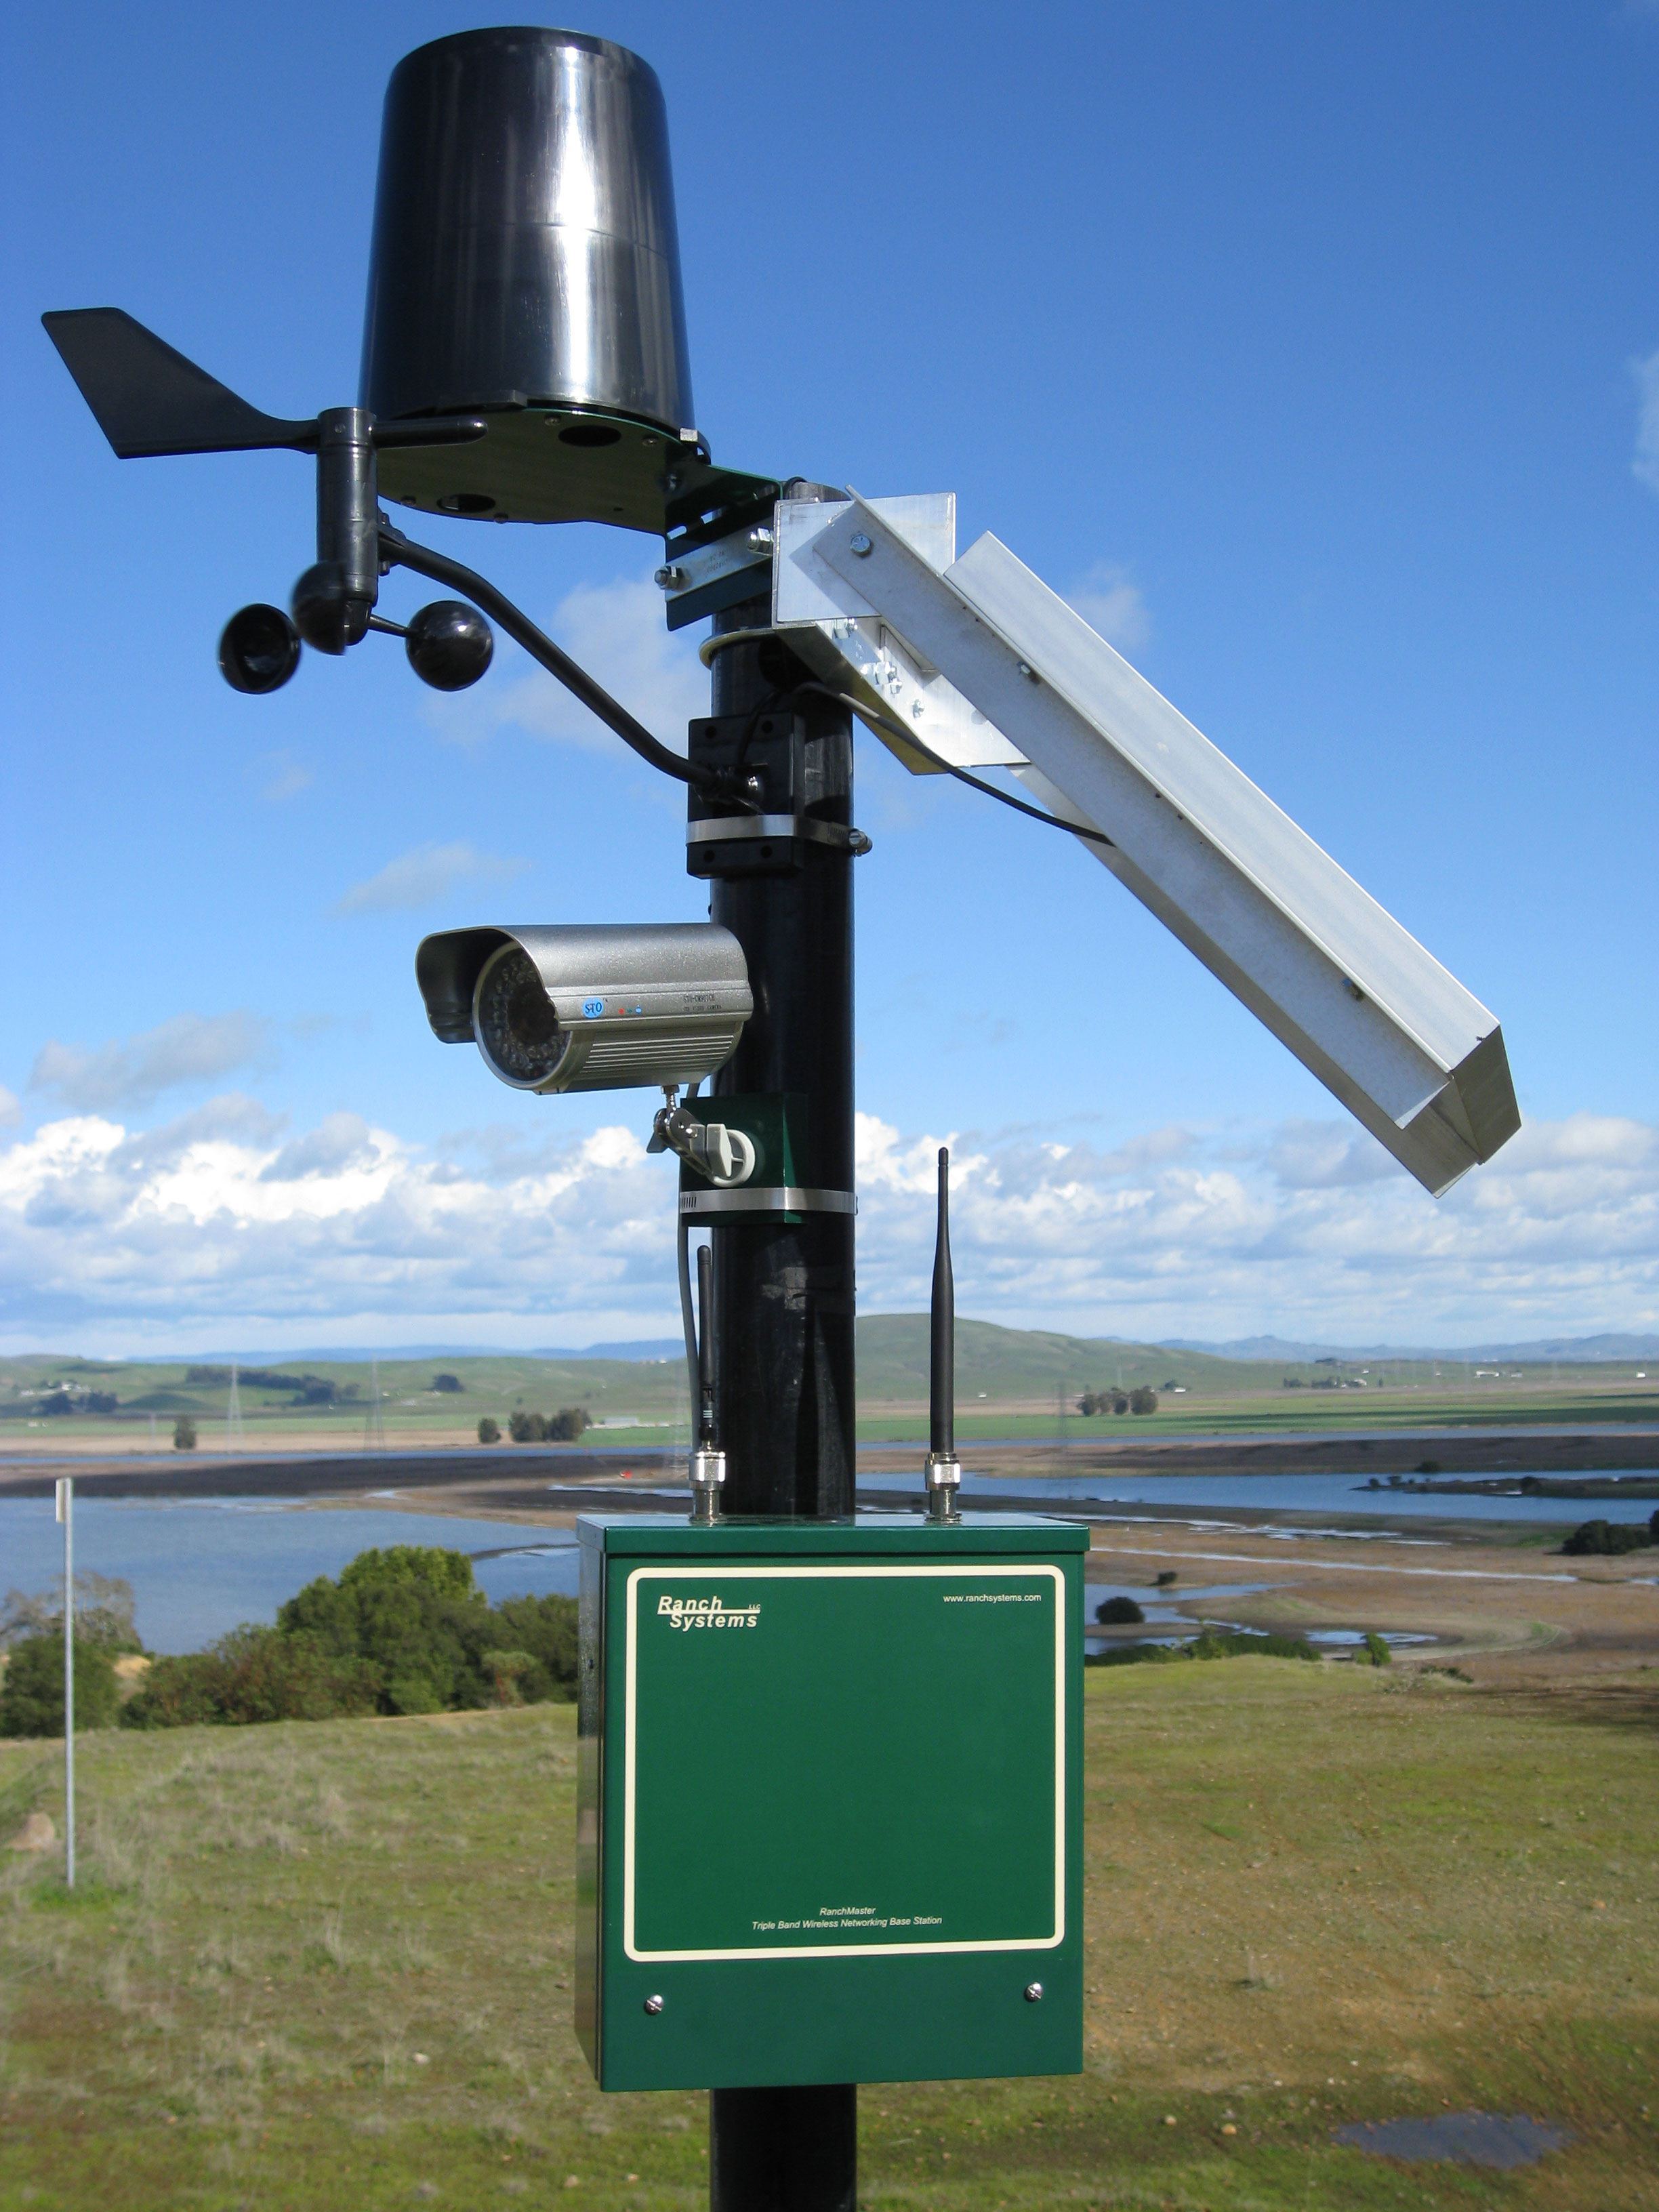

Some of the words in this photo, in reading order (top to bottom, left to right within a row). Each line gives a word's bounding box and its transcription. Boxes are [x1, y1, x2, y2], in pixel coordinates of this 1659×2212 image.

[585, 1002, 602, 1015] STO
[658, 1595, 722, 1612] Ranch
[943, 1594, 1042, 1603] www.ranchsystems.com
[670, 1614, 758, 1632] Systems
[819, 1906, 876, 1917] RanchMaster
[752, 1921, 776, 1931] Triple
[777, 1920, 801, 1929] Band
[802, 1919, 839, 1929] Wireless
[840, 1918, 888, 1927] Networking
[889, 1917, 912, 1925] Base
[913, 1916, 943, 1925] Station
